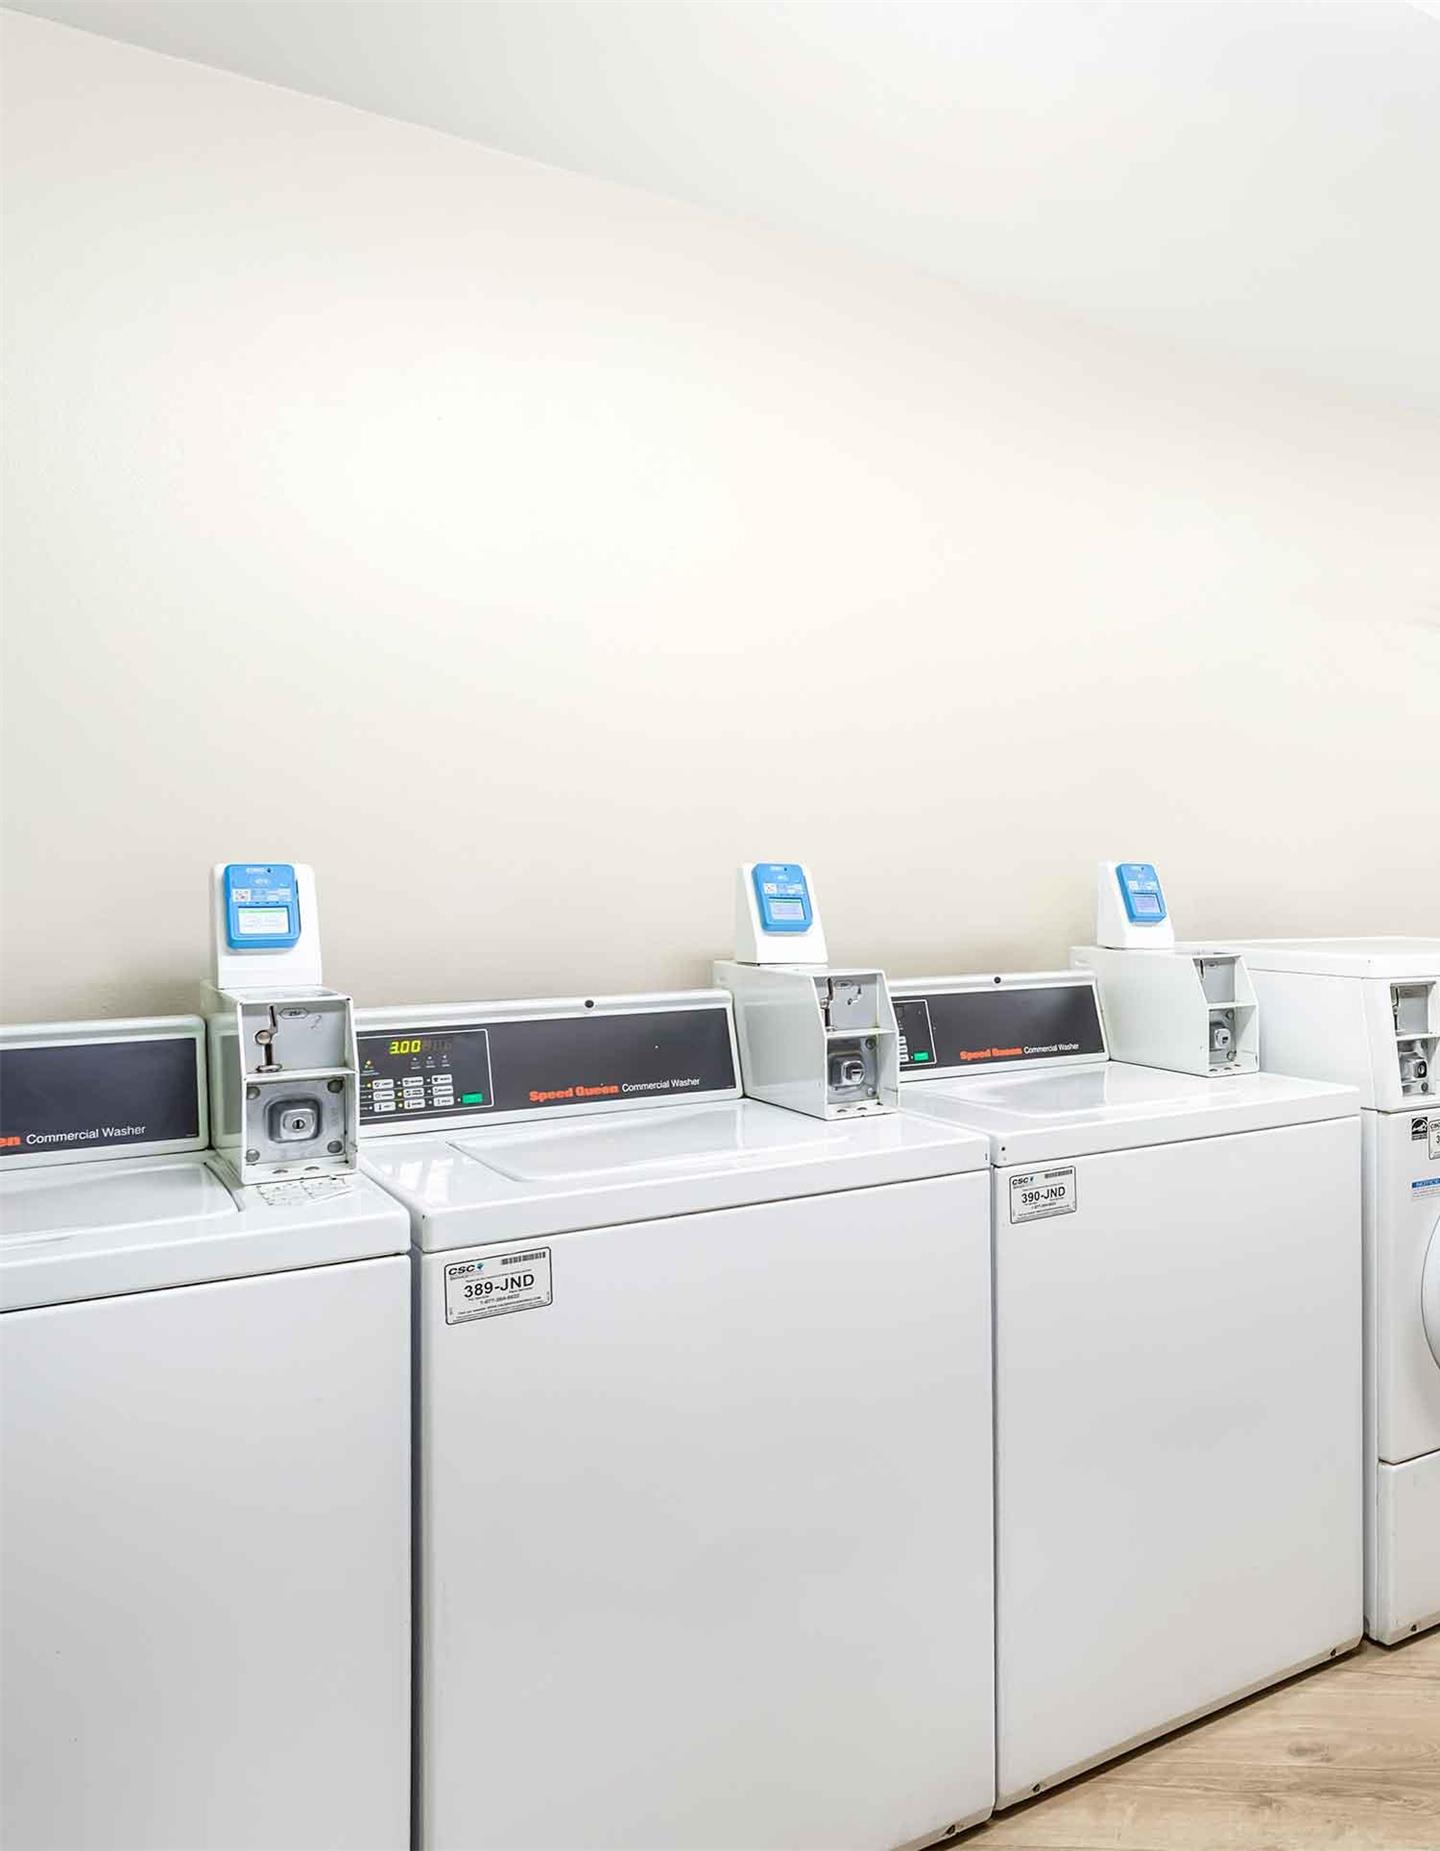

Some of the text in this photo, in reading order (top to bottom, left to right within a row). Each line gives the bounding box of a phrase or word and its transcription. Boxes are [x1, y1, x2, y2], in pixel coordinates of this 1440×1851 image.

[1023, 1044, 1058, 1055] Commercial
[1058, 1042, 1079, 1051] Washer
[528, 1077, 700, 1102] Speed Queen Commercial Washer
[26, 1128, 99, 1145] Commercial
[101, 1124, 147, 1138] Washer
[1012, 1176, 1029, 1186] CSC
[1021, 1186, 1066, 1204] 390-JND
[448, 1264, 475, 1276] CSC
[463, 1274, 535, 1298] 389-JND
